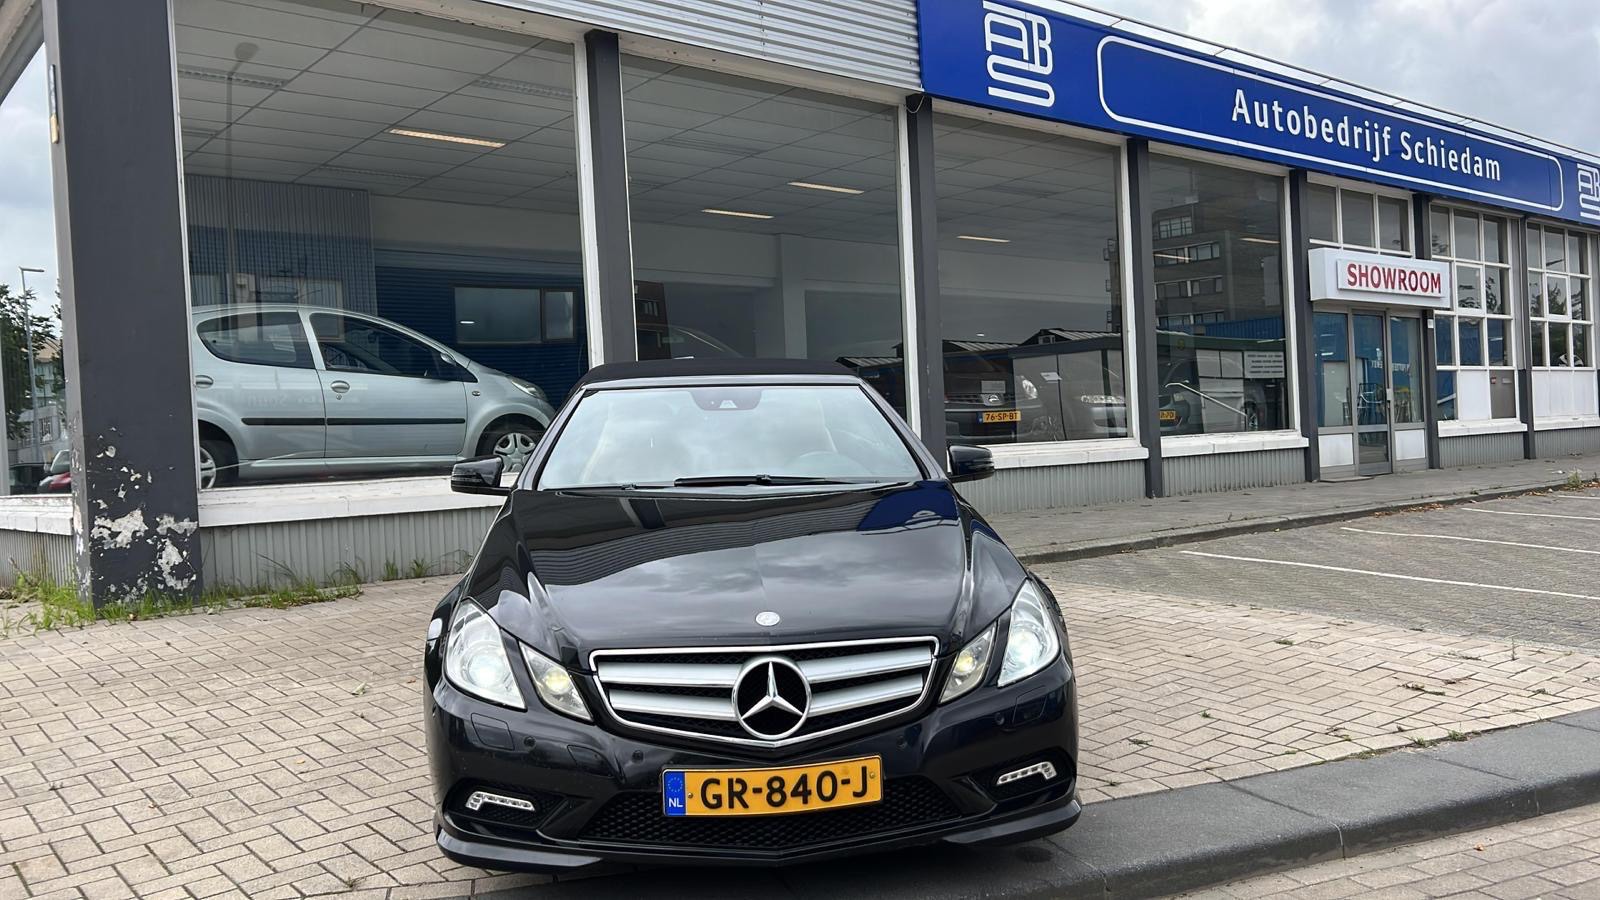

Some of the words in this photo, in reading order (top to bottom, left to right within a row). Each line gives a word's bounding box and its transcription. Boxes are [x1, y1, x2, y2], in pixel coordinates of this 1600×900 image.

[1231, 88, 1393, 163] Autobedrijf
[1399, 132, 1502, 183] Schiedam
[1346, 262, 1442, 295] SHOWROOM
[668, 797, 684, 808] NL
[700, 765, 868, 810] GR-840-J
